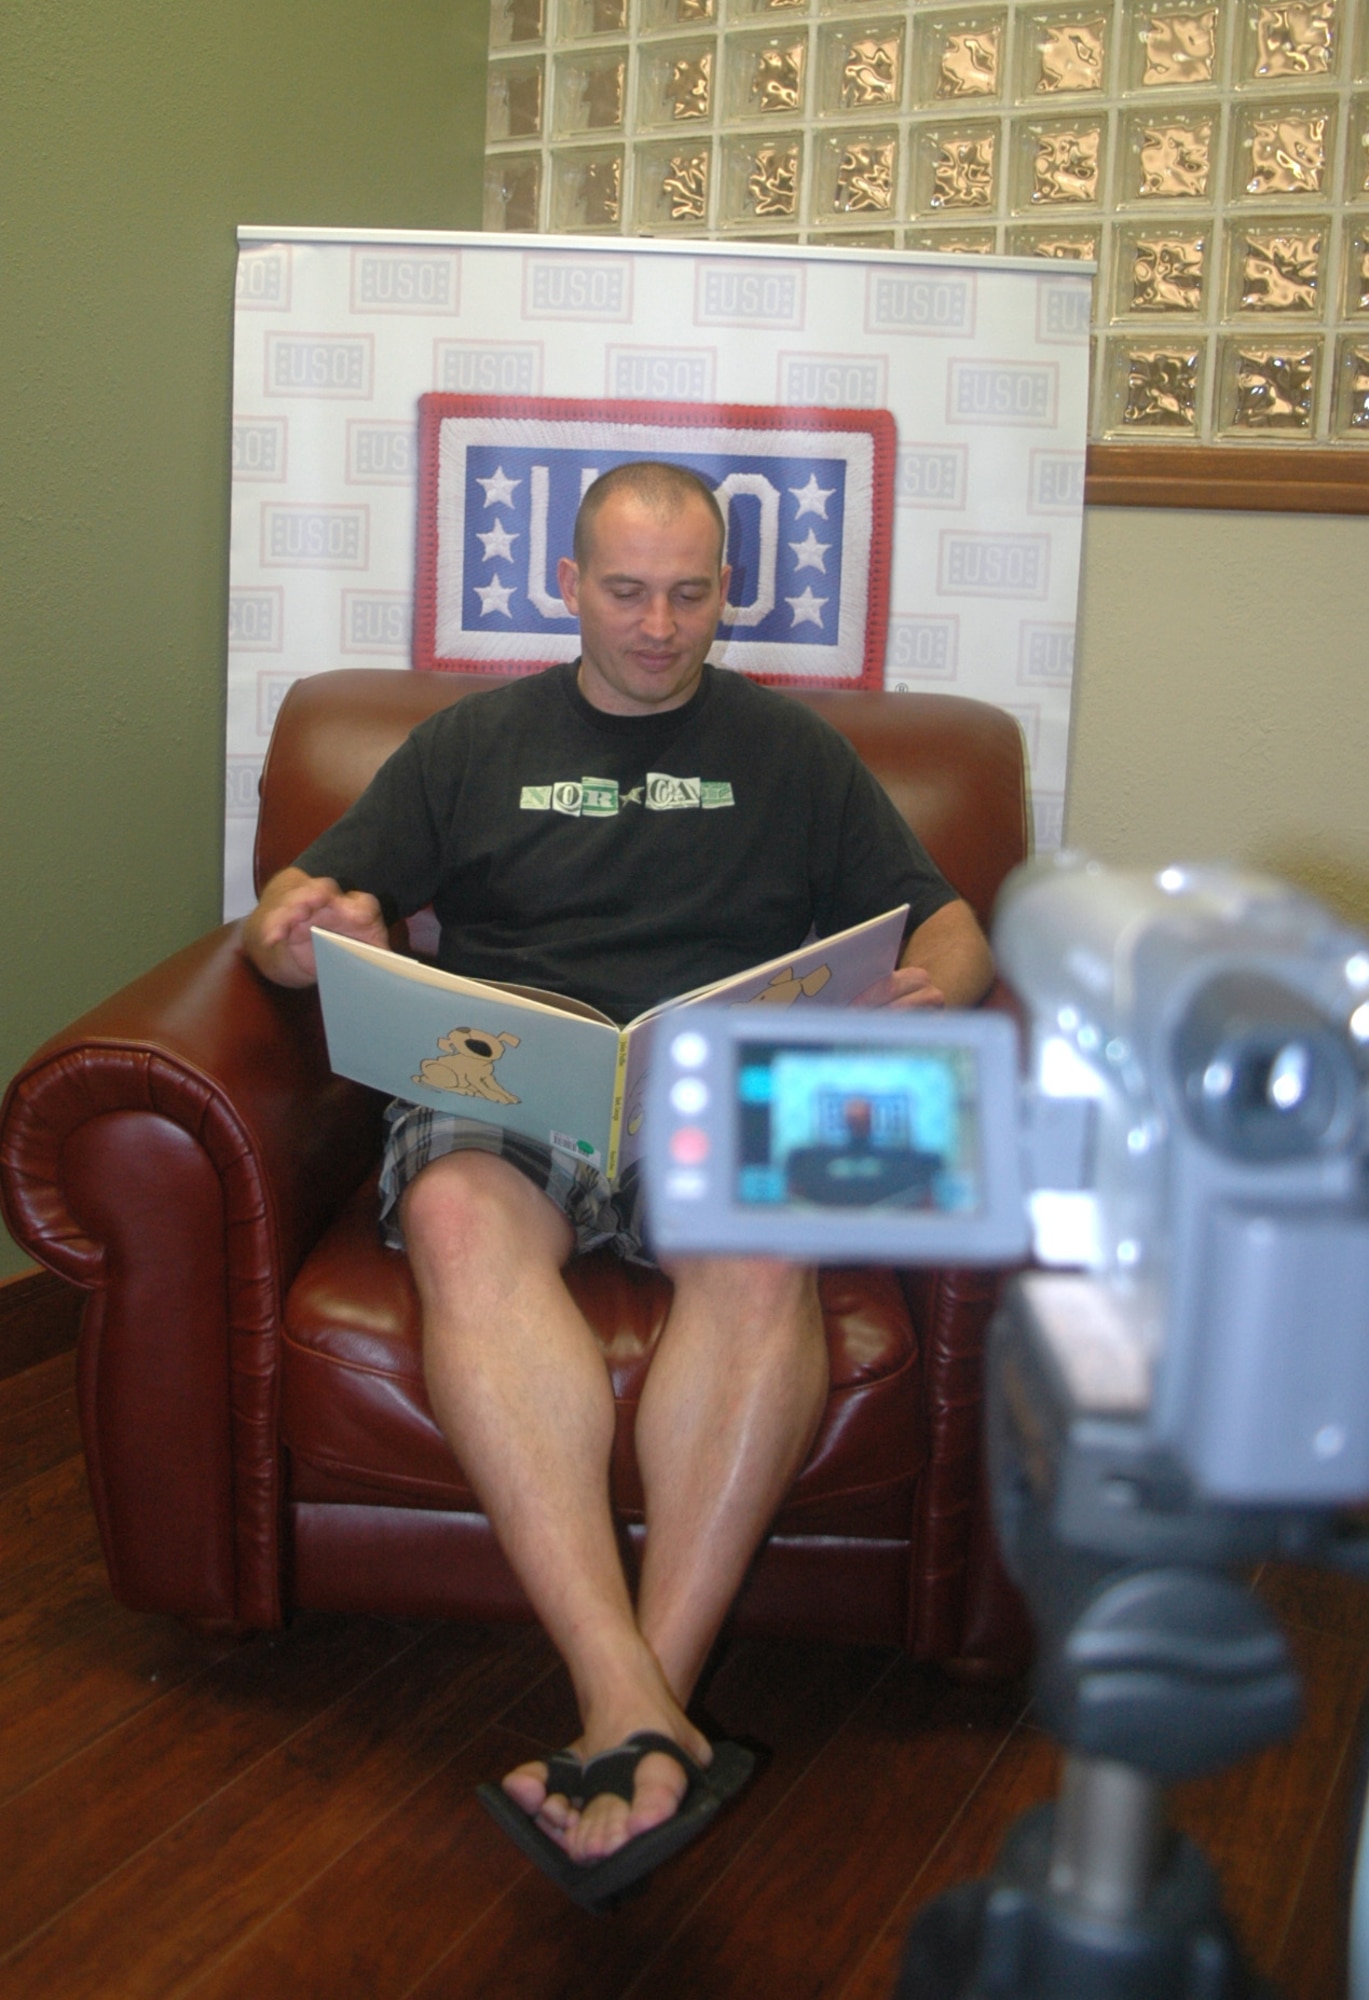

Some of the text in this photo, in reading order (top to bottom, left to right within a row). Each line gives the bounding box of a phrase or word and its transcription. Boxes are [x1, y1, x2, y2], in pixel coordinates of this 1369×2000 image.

[376, 262, 434, 299] USO
[550, 269, 607, 307] USO
[721, 275, 781, 314] USO
[892, 282, 950, 321] USO
[291, 347, 349, 384] USO
[458, 353, 518, 391] USO
[631, 359, 690, 397] USO
[802, 367, 862, 404] USO
[974, 374, 1033, 412] USO
[372, 434, 408, 471] US
[903, 457, 941, 495] SO
[286, 516, 344, 553] USO
[528, 465, 780, 626] UO
[964, 547, 1023, 583] USO
[366, 604, 402, 640] US
[896, 628, 932, 664] SO
